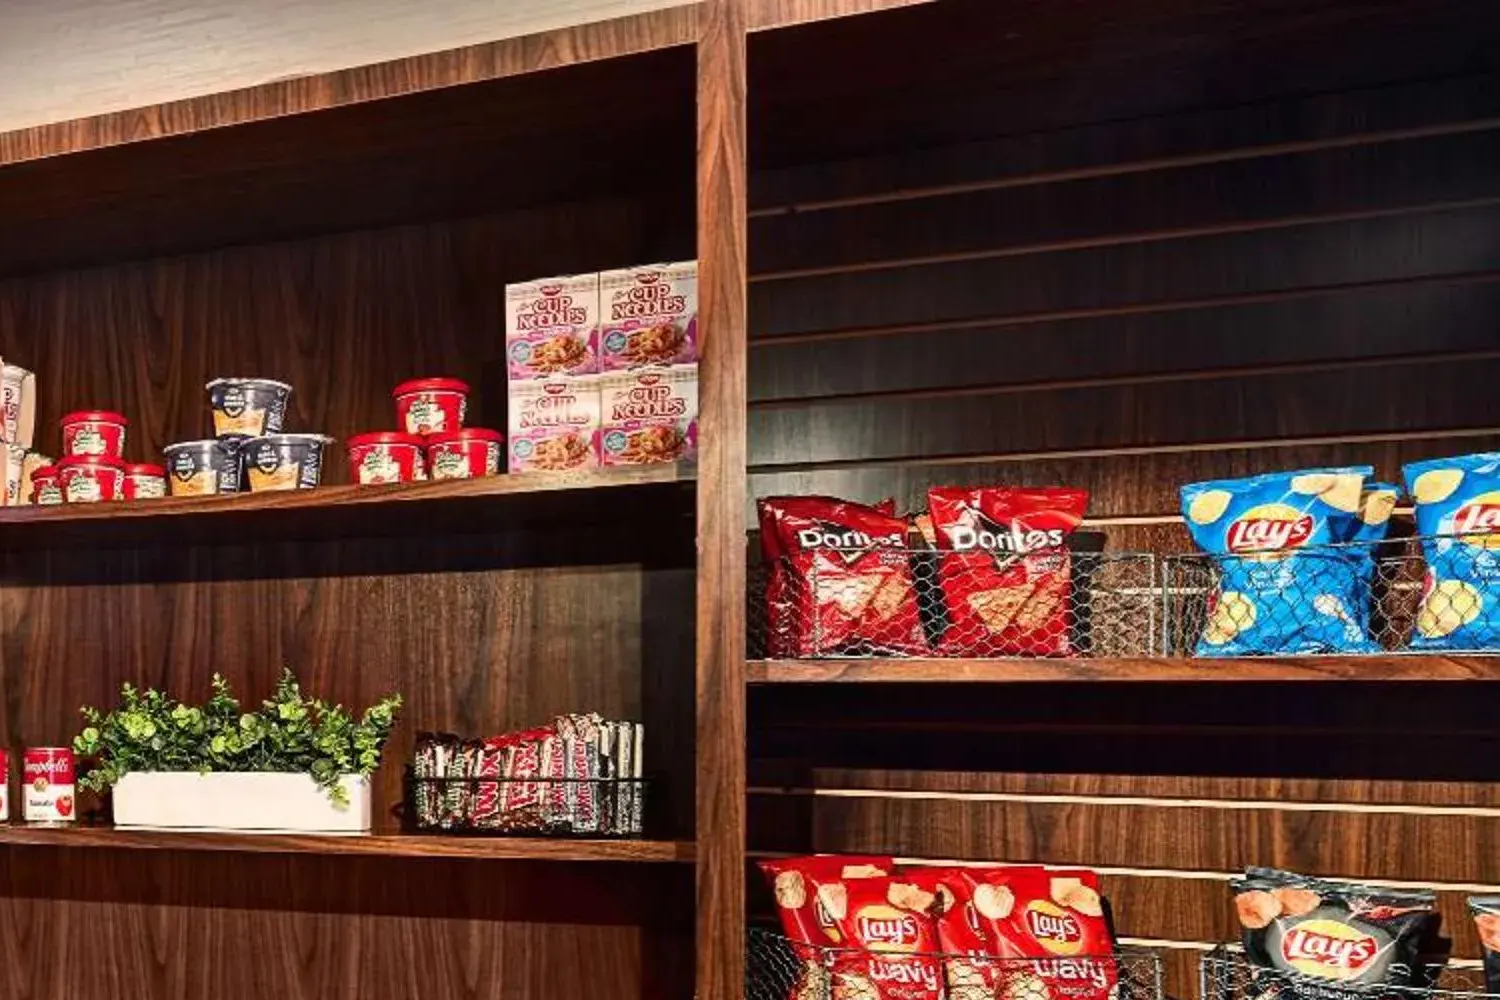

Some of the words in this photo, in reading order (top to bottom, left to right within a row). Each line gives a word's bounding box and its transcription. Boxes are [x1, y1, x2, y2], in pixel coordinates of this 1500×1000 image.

[628, 284, 671, 302] CUP
[533, 296, 573, 314] CUP
[612, 296, 687, 321] NOODLES
[517, 308, 587, 331] NOODLES
[628, 387, 671, 404] CUP
[612, 398, 687, 421] NOODLES
[951, 525, 1063, 553] Doritos
